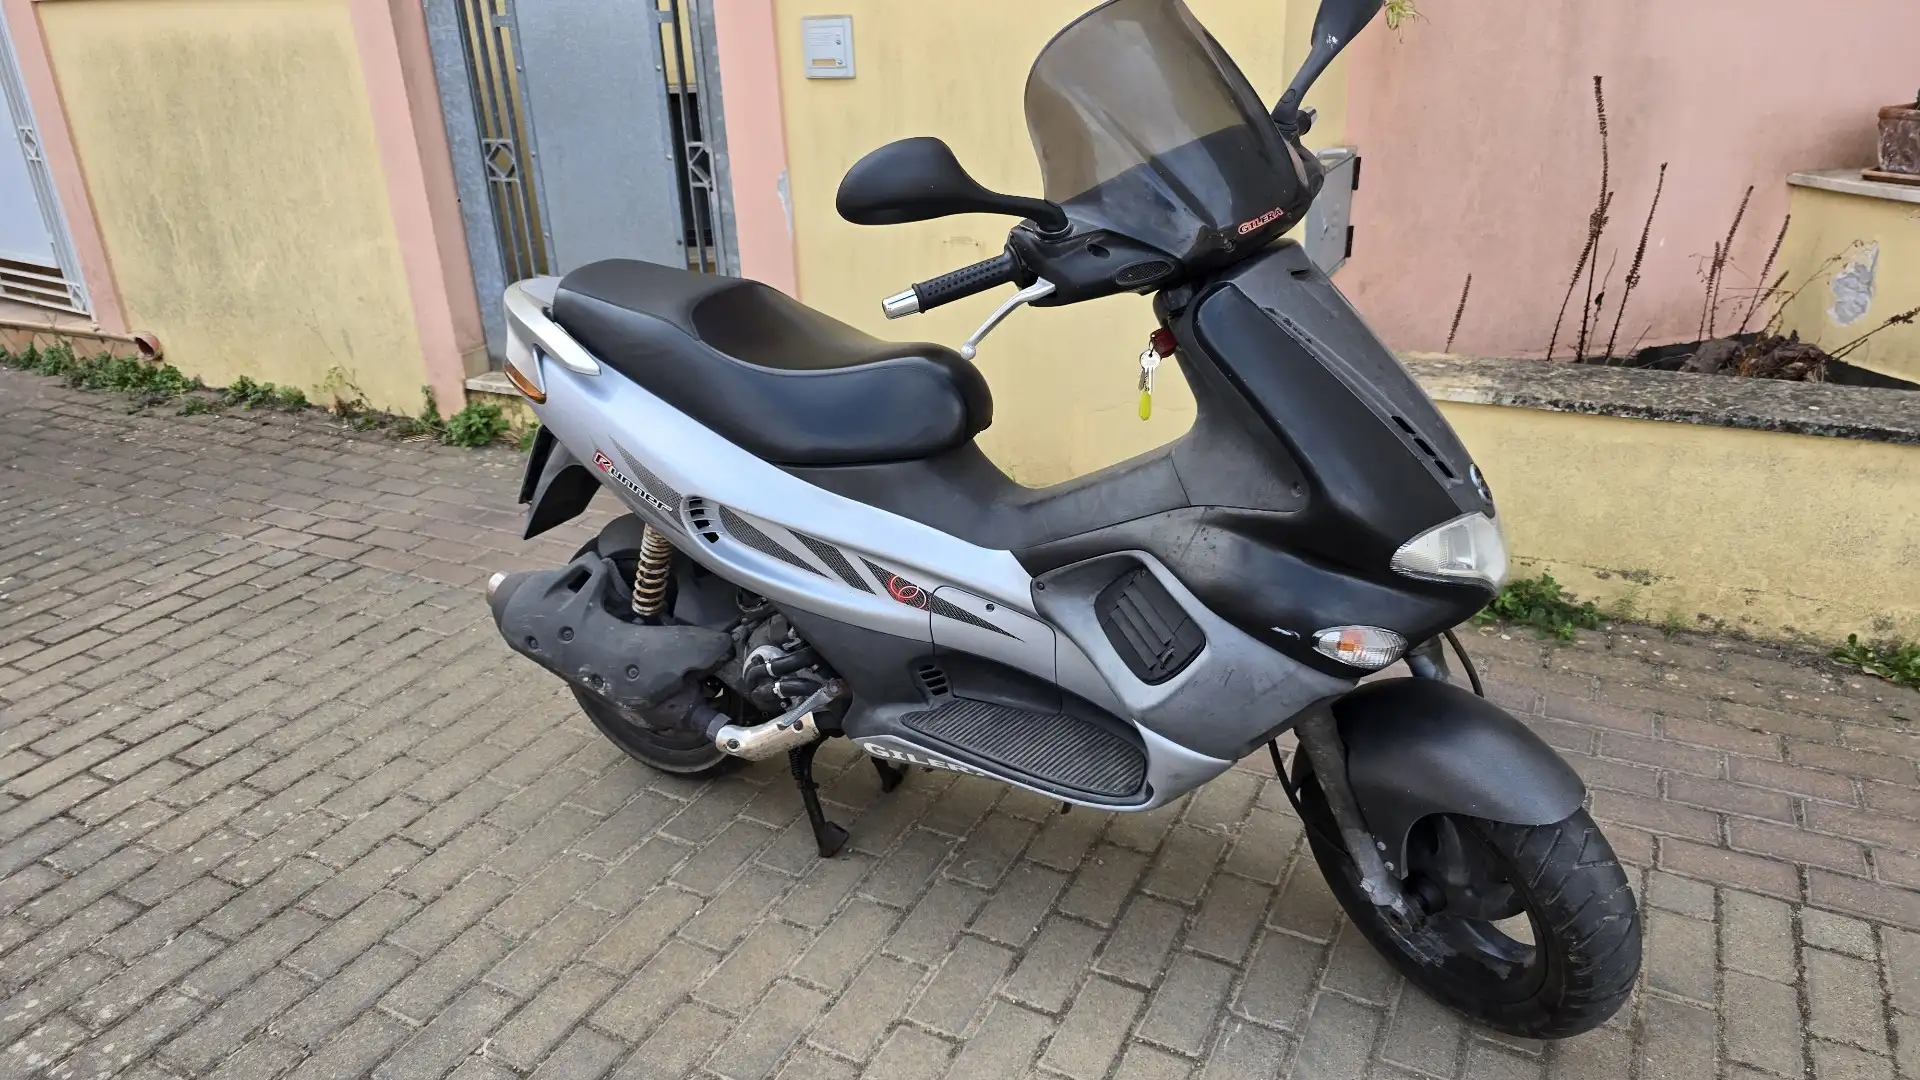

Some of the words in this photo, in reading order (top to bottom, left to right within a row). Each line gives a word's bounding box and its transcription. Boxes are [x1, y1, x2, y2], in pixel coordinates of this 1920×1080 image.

[1238, 207, 1284, 235] GILERA
[592, 449, 673, 512] Runner
[863, 742, 985, 777] GILER
